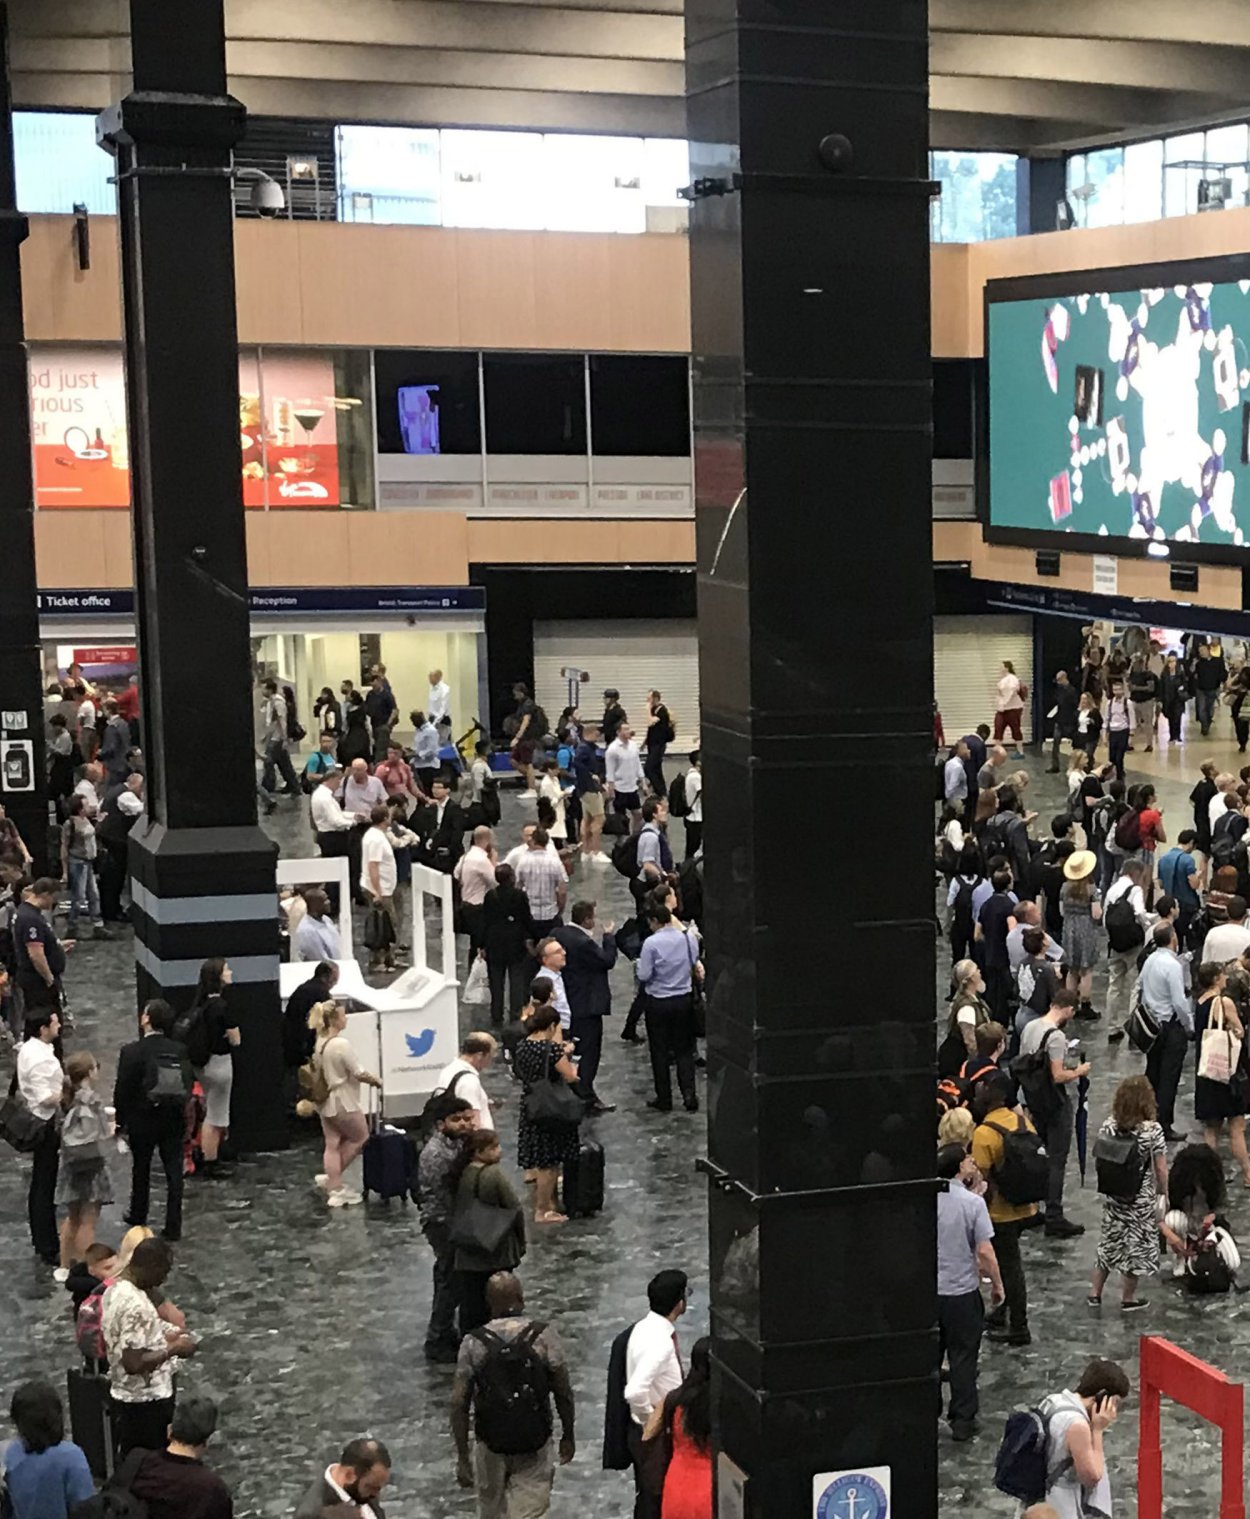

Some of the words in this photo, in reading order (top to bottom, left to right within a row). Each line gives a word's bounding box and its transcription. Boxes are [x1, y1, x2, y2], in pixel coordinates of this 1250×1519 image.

[31, 369, 50, 389] od
[58, 368, 100, 393] just
[32, 398, 84, 413] rious
[46, 596, 79, 607] Ticket
[81, 595, 111, 607] office
[252, 596, 298, 606] Reception
